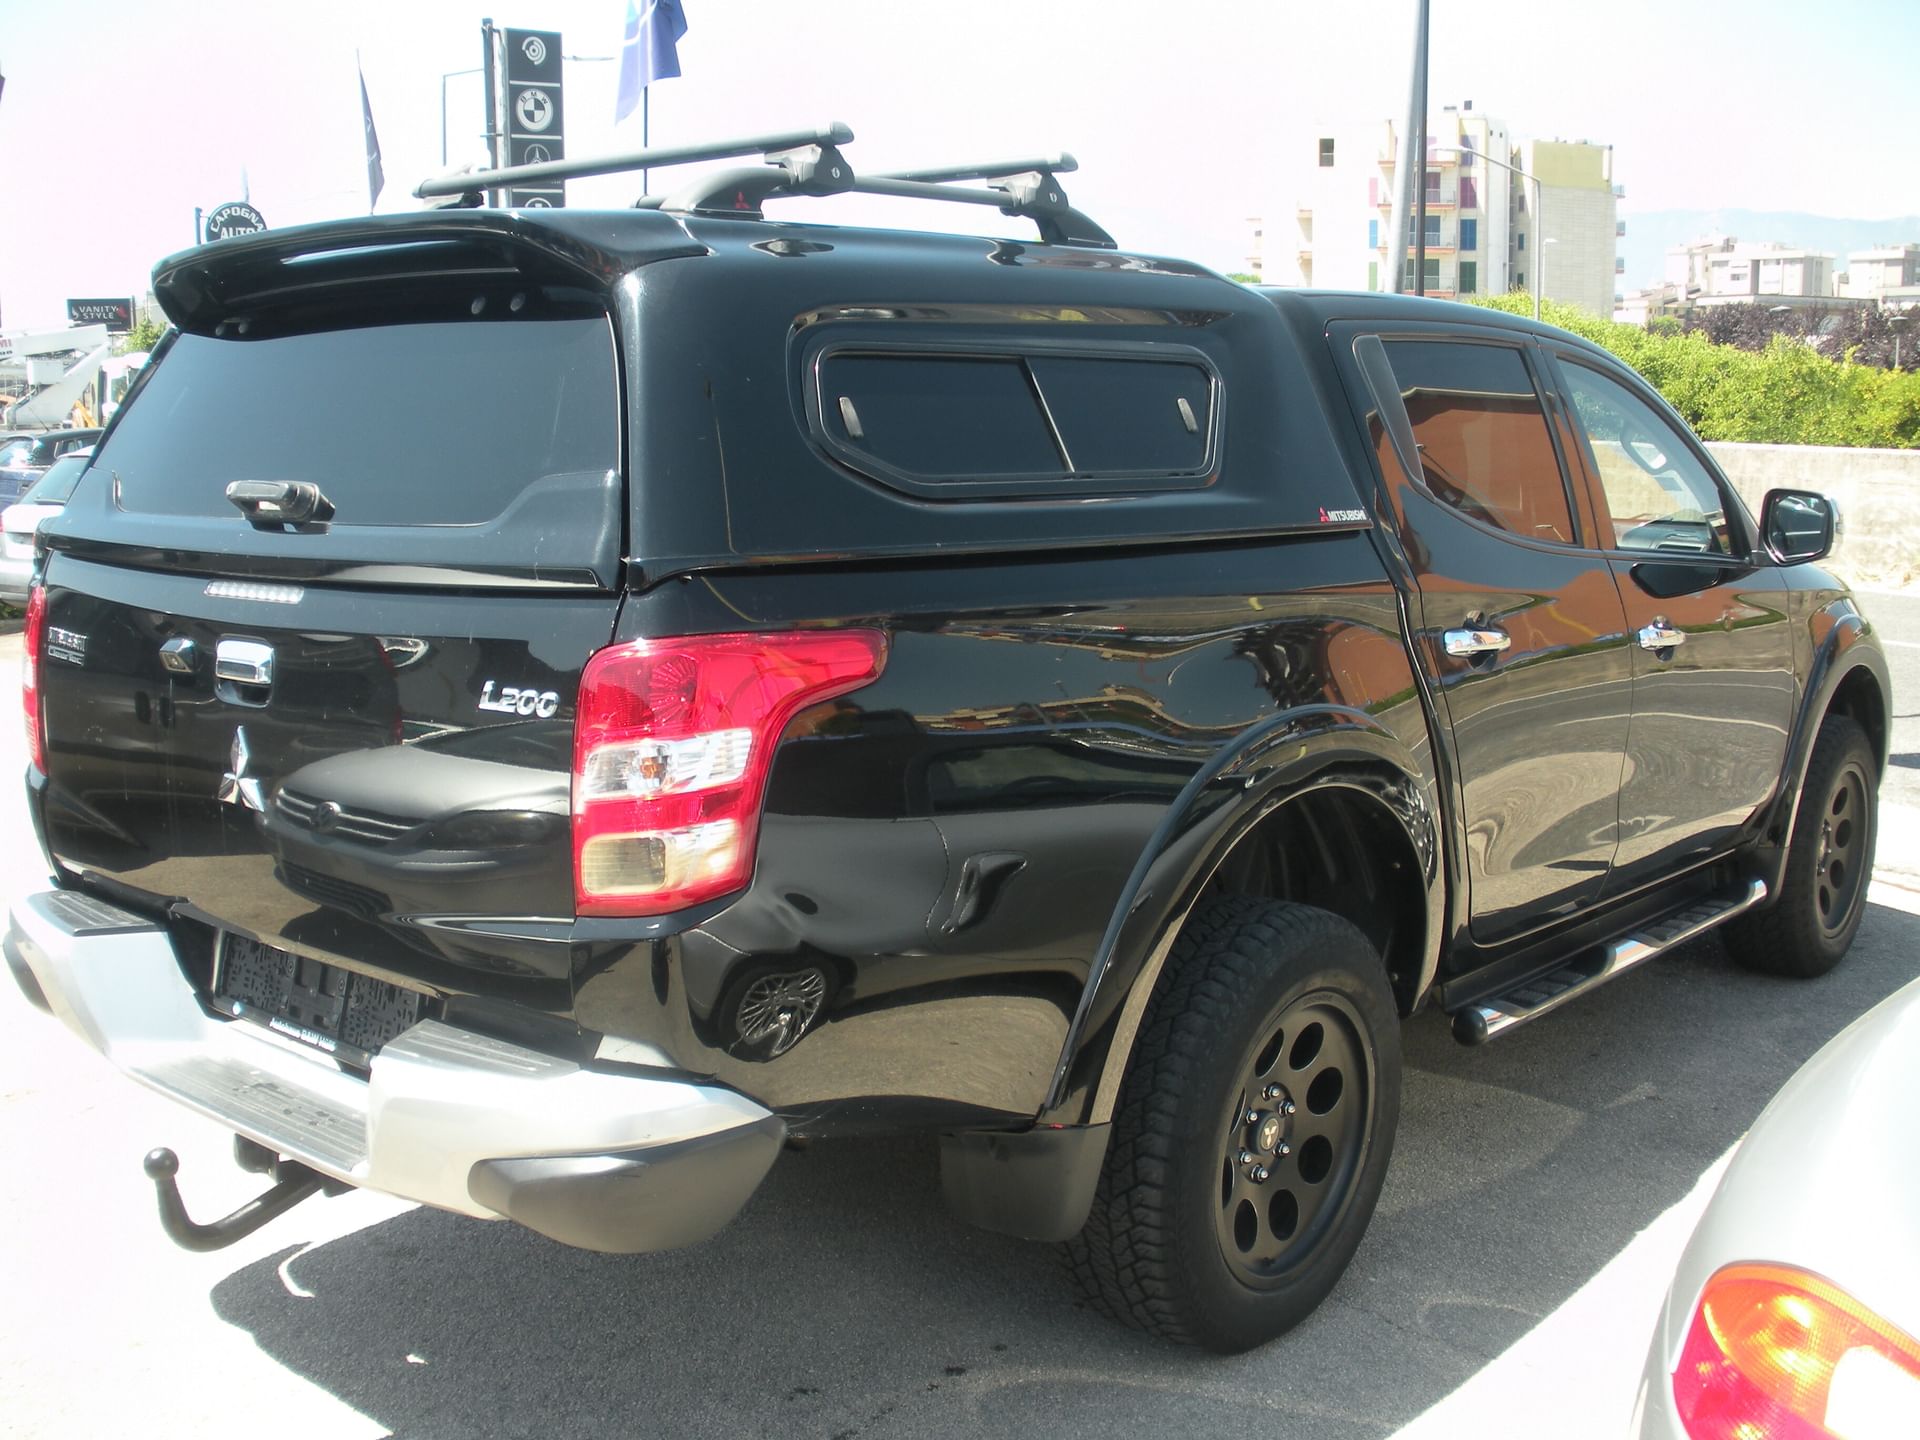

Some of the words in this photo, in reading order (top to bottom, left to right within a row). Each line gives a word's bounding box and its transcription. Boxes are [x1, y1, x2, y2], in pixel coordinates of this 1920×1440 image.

[79, 305, 117, 313] VANITY
[82, 312, 115, 320] STYLE
[478, 680, 560, 718] L200
